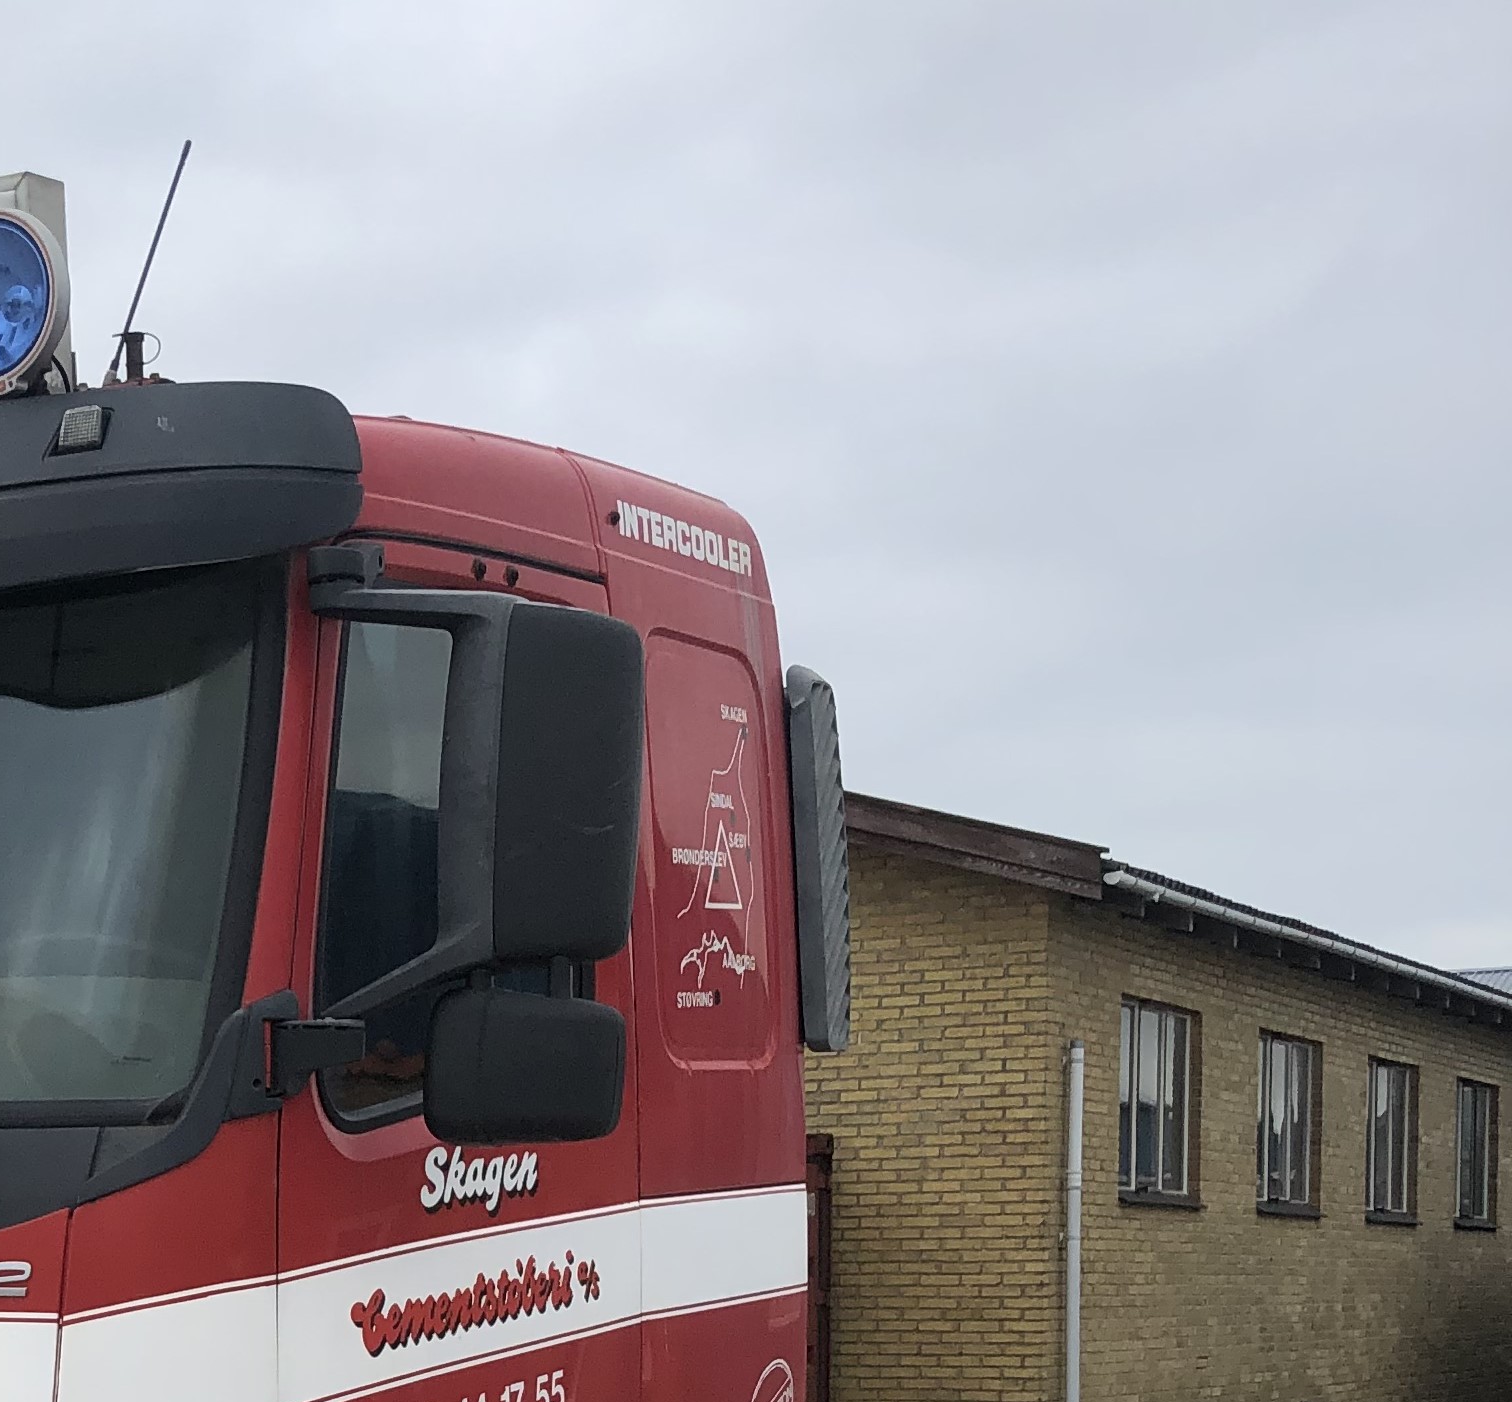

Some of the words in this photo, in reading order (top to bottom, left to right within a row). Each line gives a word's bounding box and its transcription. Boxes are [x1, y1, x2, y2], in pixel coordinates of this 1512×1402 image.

[616, 500, 752, 577] INTERCOOLER
[720, 703, 748, 723] SKAGEN
[421, 1146, 538, 1214] Skagen
